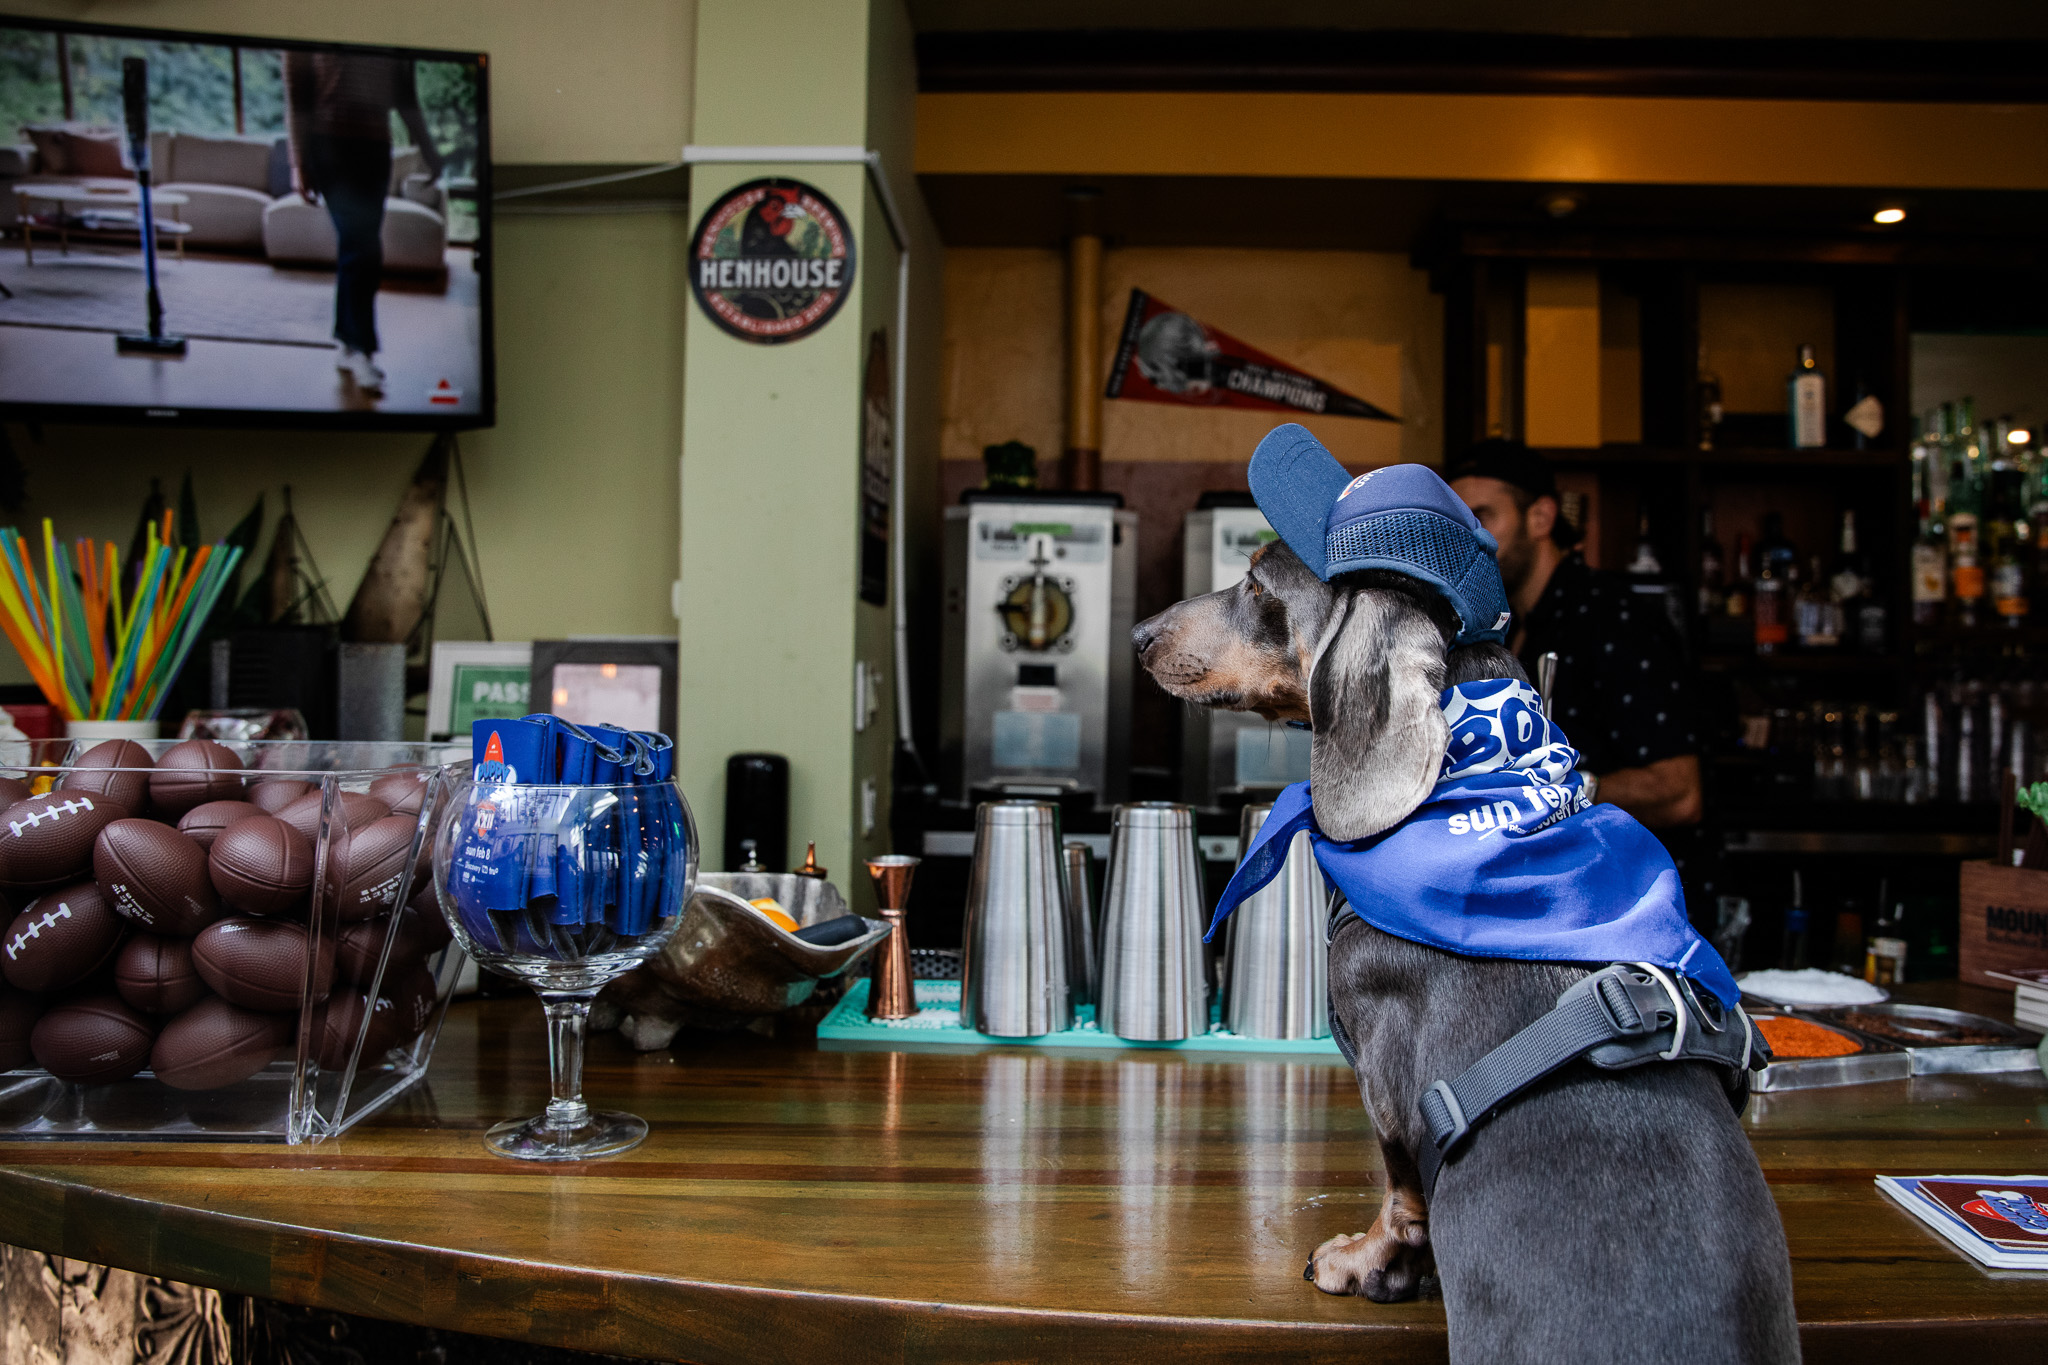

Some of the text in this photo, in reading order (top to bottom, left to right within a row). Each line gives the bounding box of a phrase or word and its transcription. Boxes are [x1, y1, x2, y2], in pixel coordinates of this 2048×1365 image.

[700, 259, 843, 289] HENHOUSE
[477, 760, 510, 783] PUPPY
[1448, 799, 1522, 836] sun
[465, 846, 491, 860] sun feb 8
